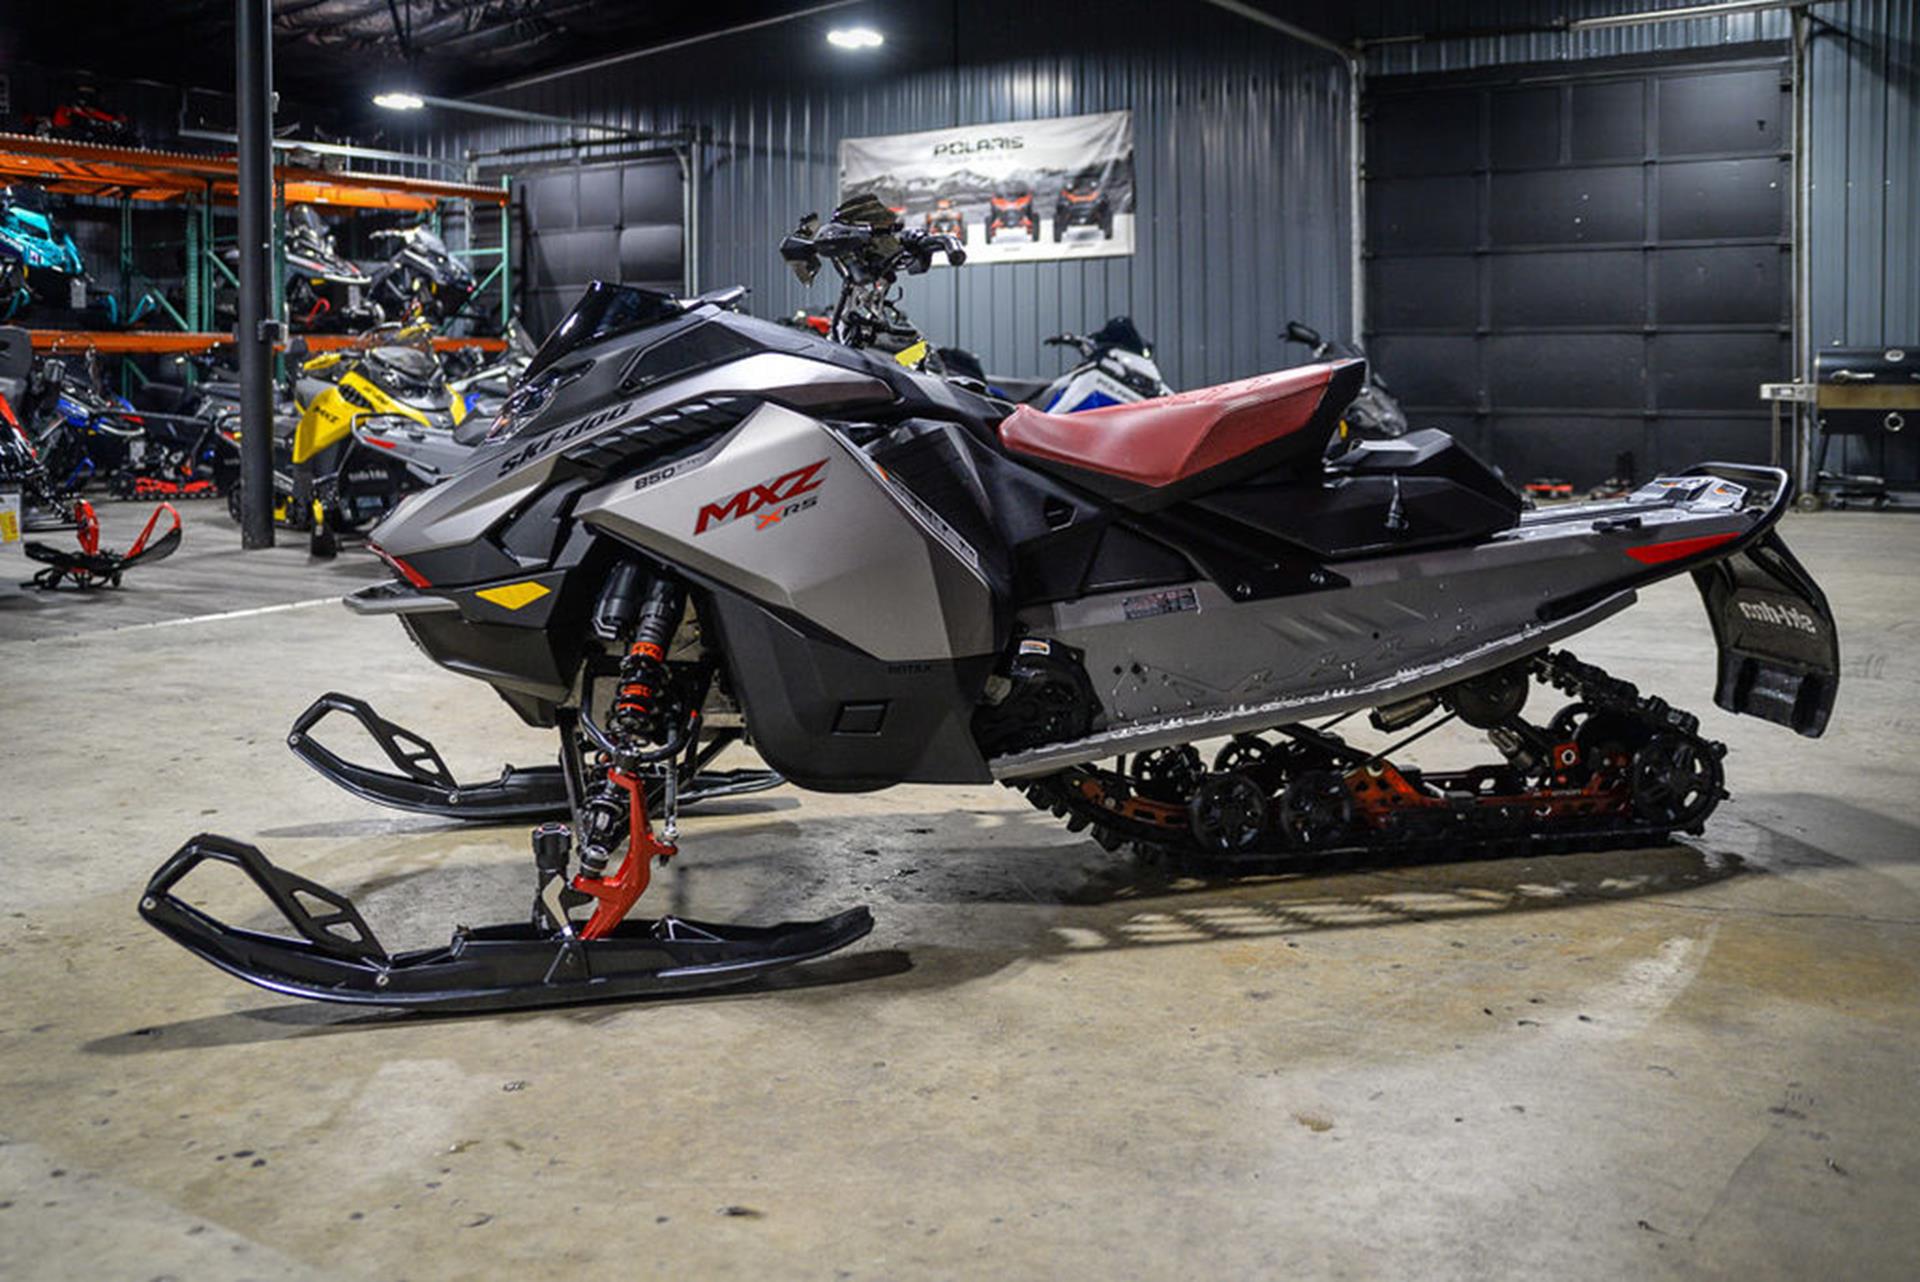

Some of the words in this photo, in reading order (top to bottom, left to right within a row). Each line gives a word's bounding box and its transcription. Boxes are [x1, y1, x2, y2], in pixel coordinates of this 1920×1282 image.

[933, 136, 1024, 156] POLARIS
[634, 467, 675, 490] 850
[693, 456, 831, 536] MXZ
